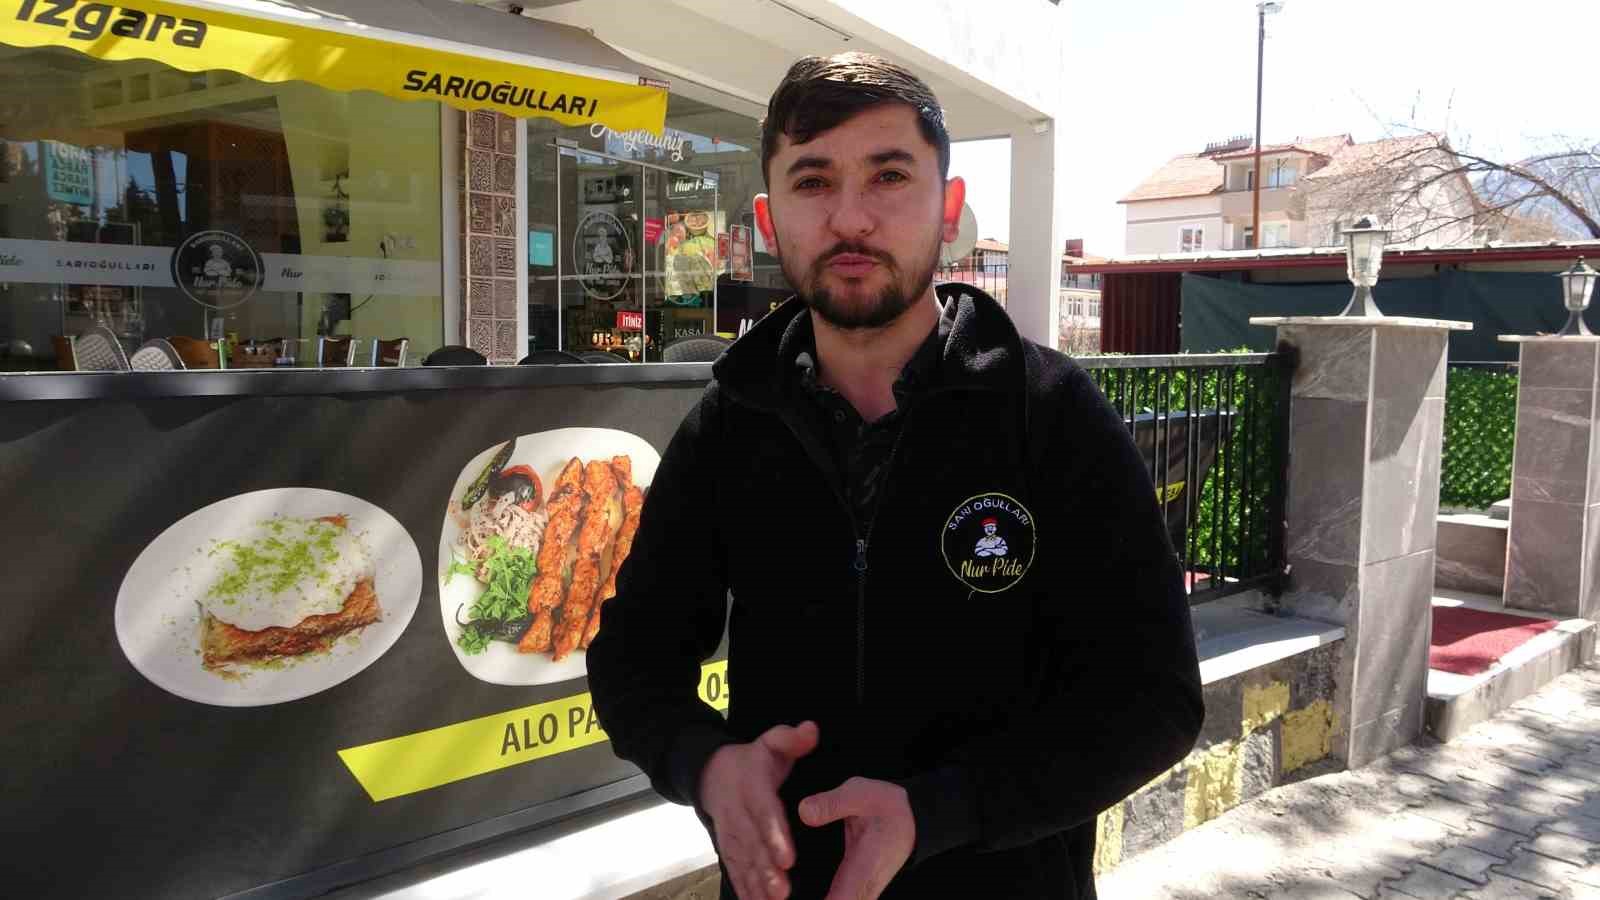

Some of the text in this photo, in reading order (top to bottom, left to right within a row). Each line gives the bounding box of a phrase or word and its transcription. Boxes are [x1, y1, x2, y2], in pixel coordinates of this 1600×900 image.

[403, 70, 597, 117] SARIOĞULLARI
[0, 253, 24, 266] ide
[674, 328, 701, 338] KASA
[960, 557, 1023, 578] Nur Pide
[501, 712, 559, 756] ALO
